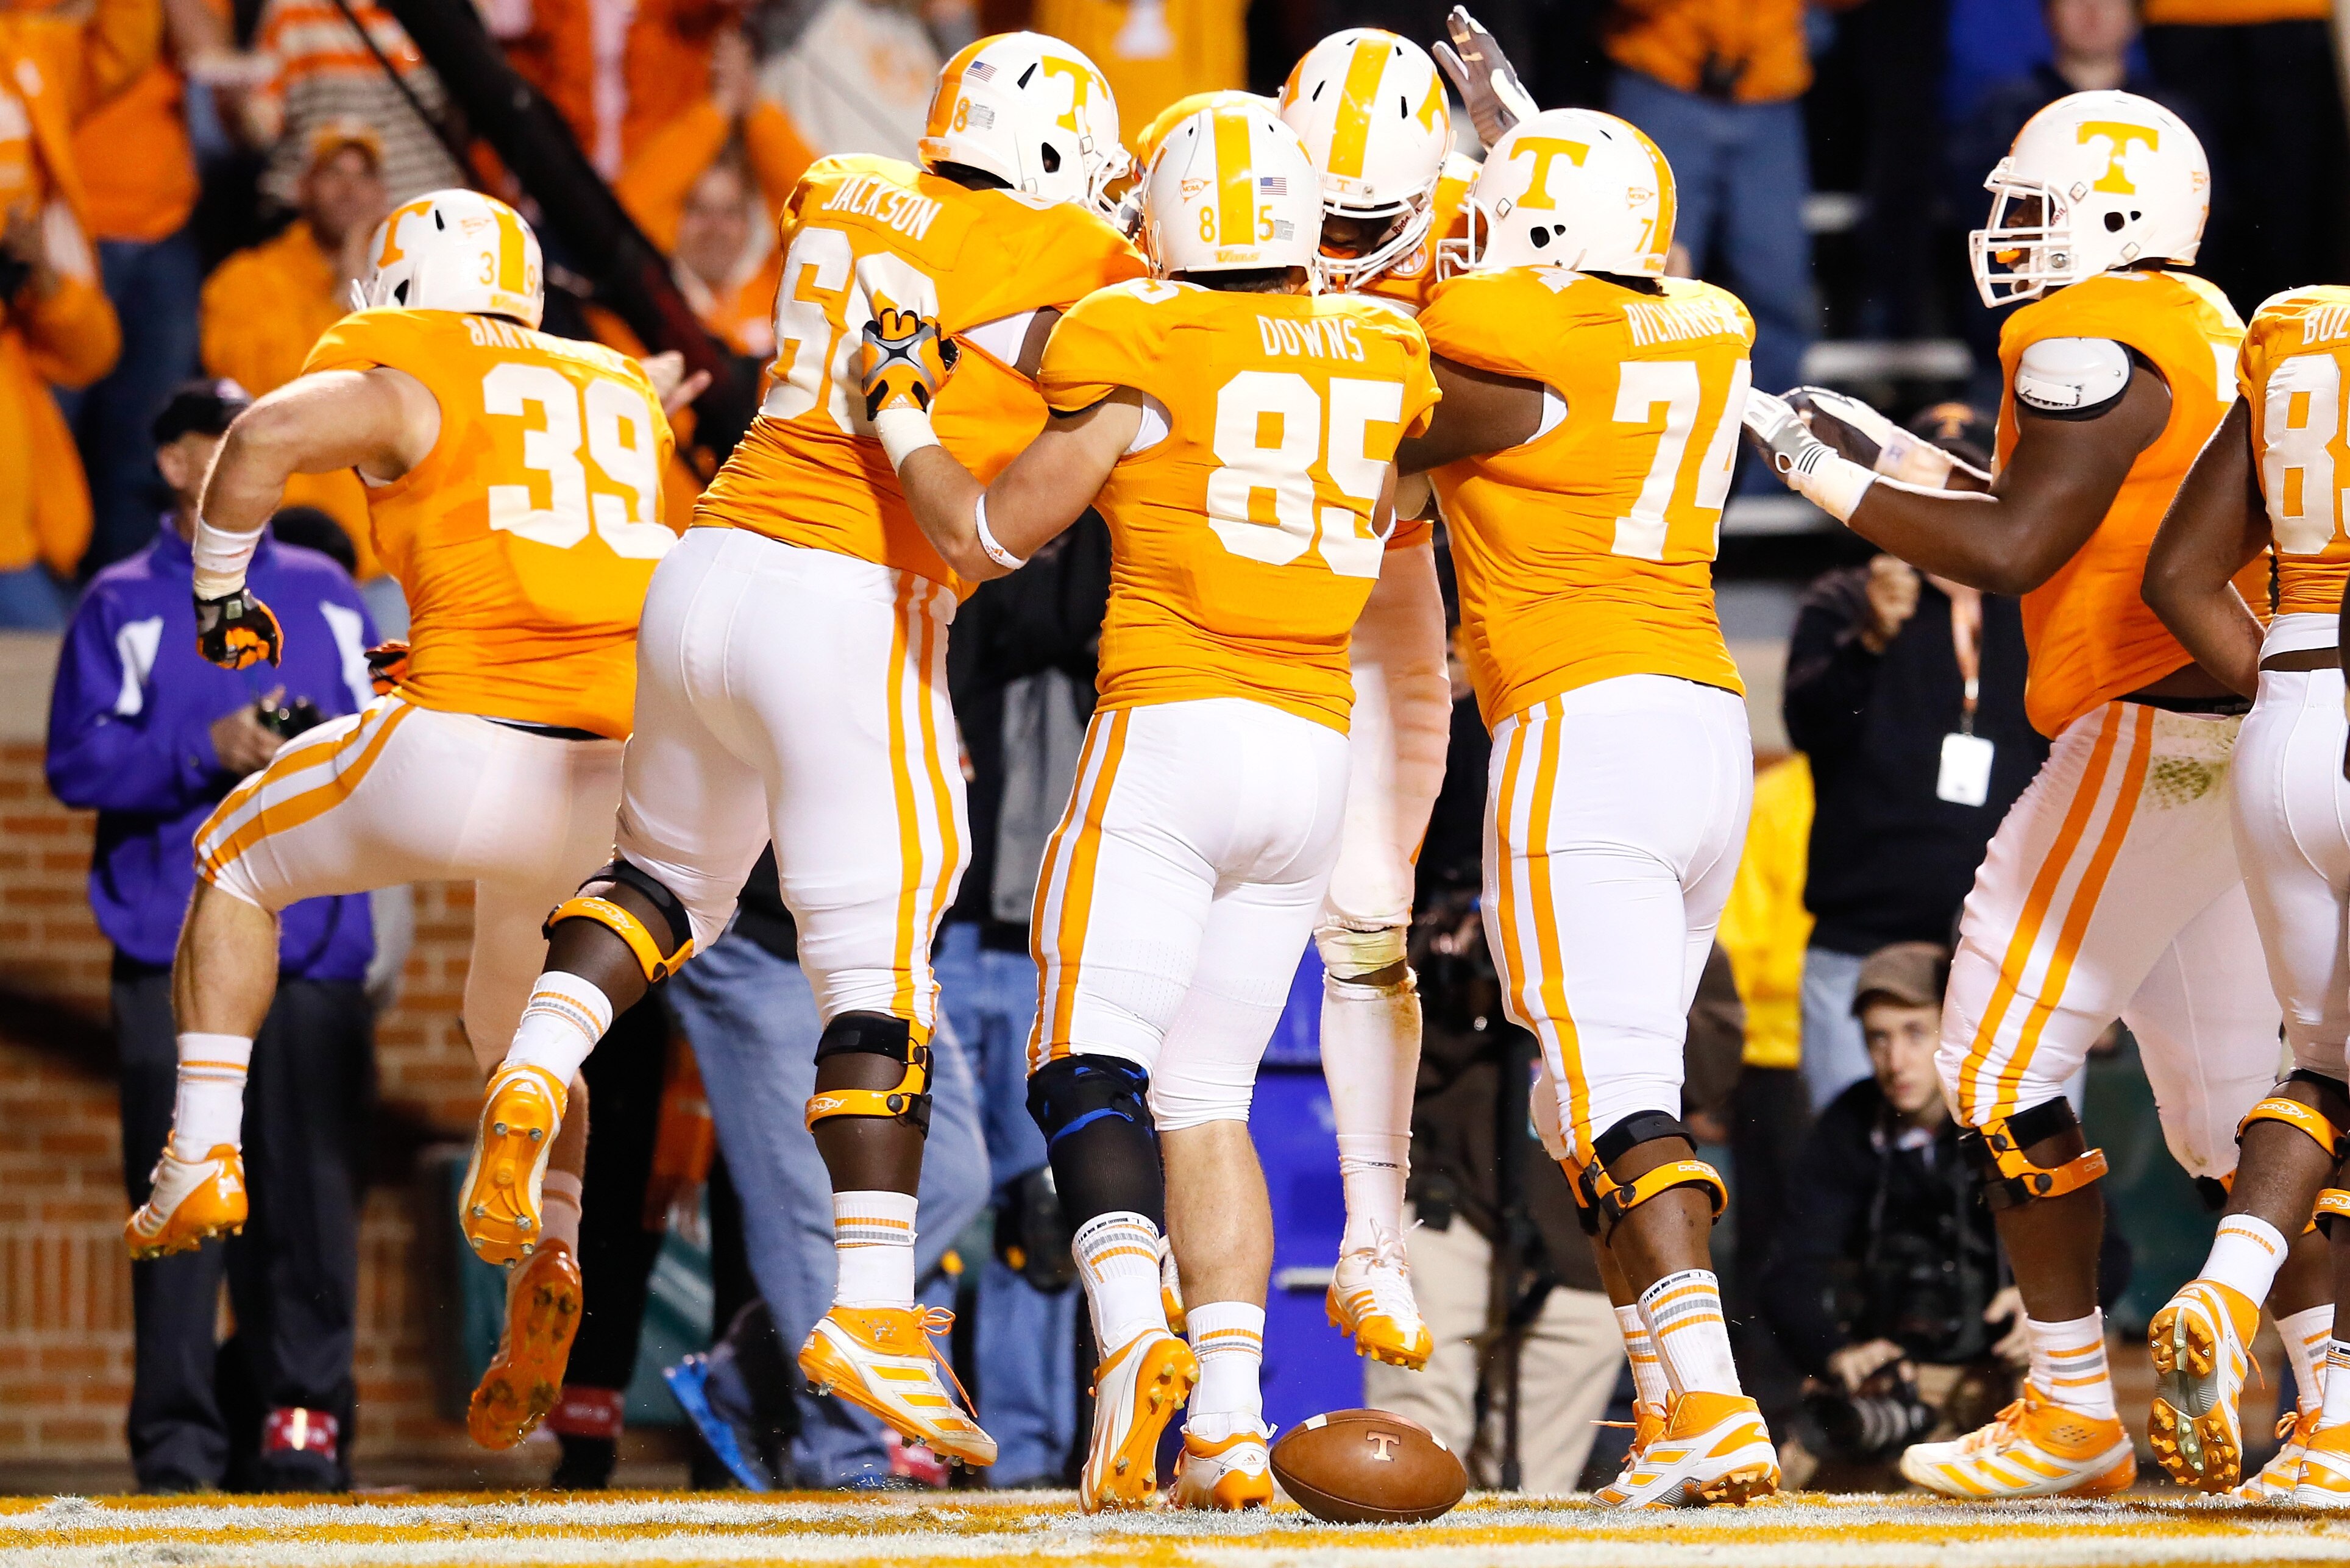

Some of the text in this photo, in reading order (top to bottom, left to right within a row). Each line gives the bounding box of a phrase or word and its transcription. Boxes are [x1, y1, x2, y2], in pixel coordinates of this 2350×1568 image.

[1508, 137, 1591, 211] T
[2077, 121, 2159, 196] T
[822, 175, 942, 241] JACKSON
[1337, 179, 1351, 192] T
[1635, 218, 1653, 253] 7
[1257, 315, 1365, 361] DOWNS
[2301, 304, 2350, 345] BUL
[482, 362, 678, 559] 39
[1206, 371, 1404, 579] 85
[2263, 353, 2350, 555] 8
[806, 1097, 848, 1113] ONJOY
[2257, 1101, 2313, 1119] DONJOY
[1366, 1431, 1400, 1461] T
